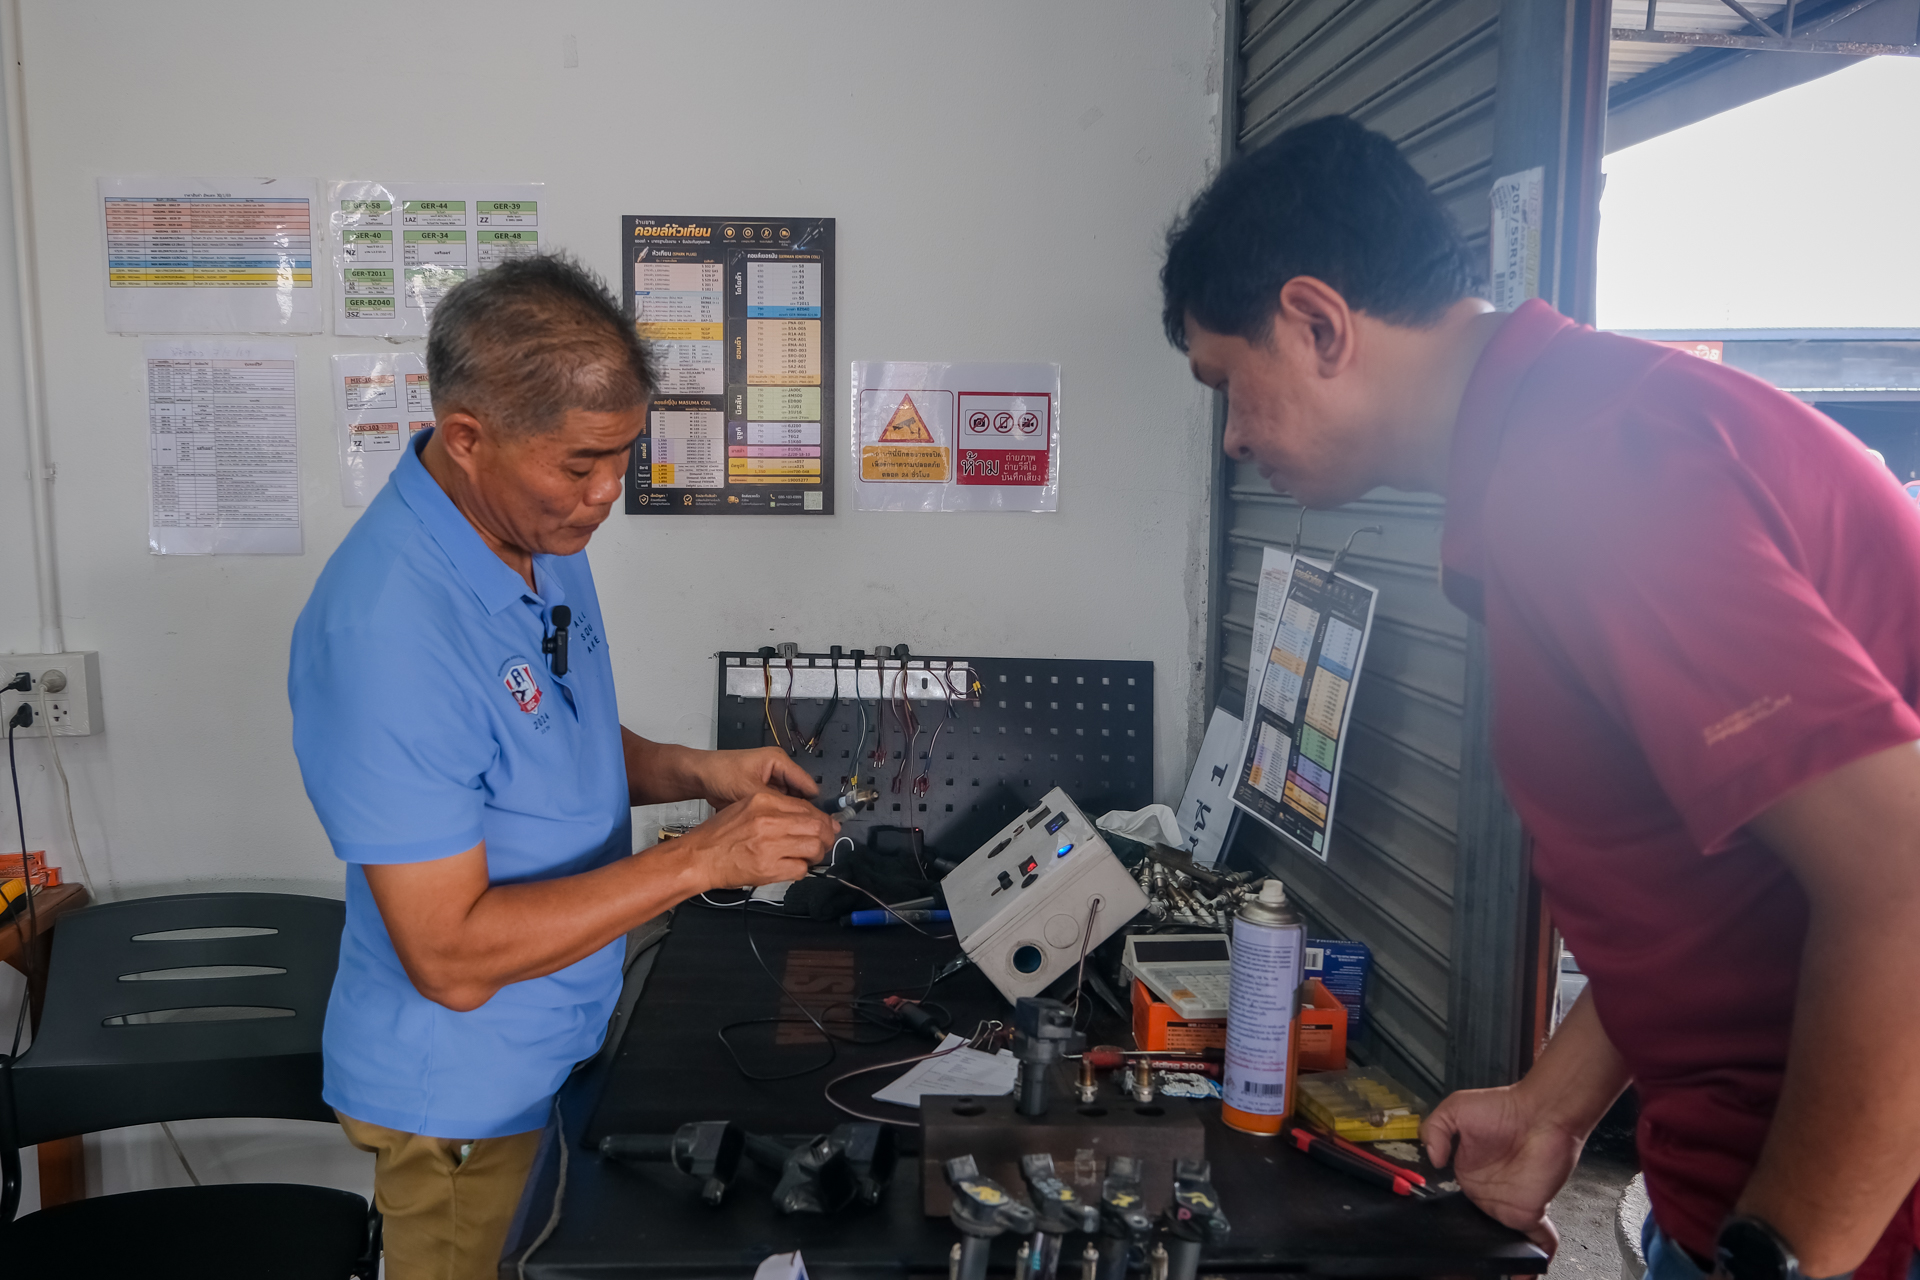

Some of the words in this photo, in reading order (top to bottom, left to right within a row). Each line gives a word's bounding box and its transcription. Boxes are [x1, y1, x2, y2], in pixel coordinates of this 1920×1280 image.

[634, 224, 711, 237] คอยล์หัวเทียน
[1509, 182, 1520, 280] 205/55R16
[961, 450, 1000, 476] ห้าม
[1006, 453, 1036, 462] ถ่ายภาพ
[1004, 461, 1037, 471] ถ่ายวีดีโอ
[1001, 471, 1042, 482] บันทึกเสียง
[1182, 1062, 1204, 1070] 300
